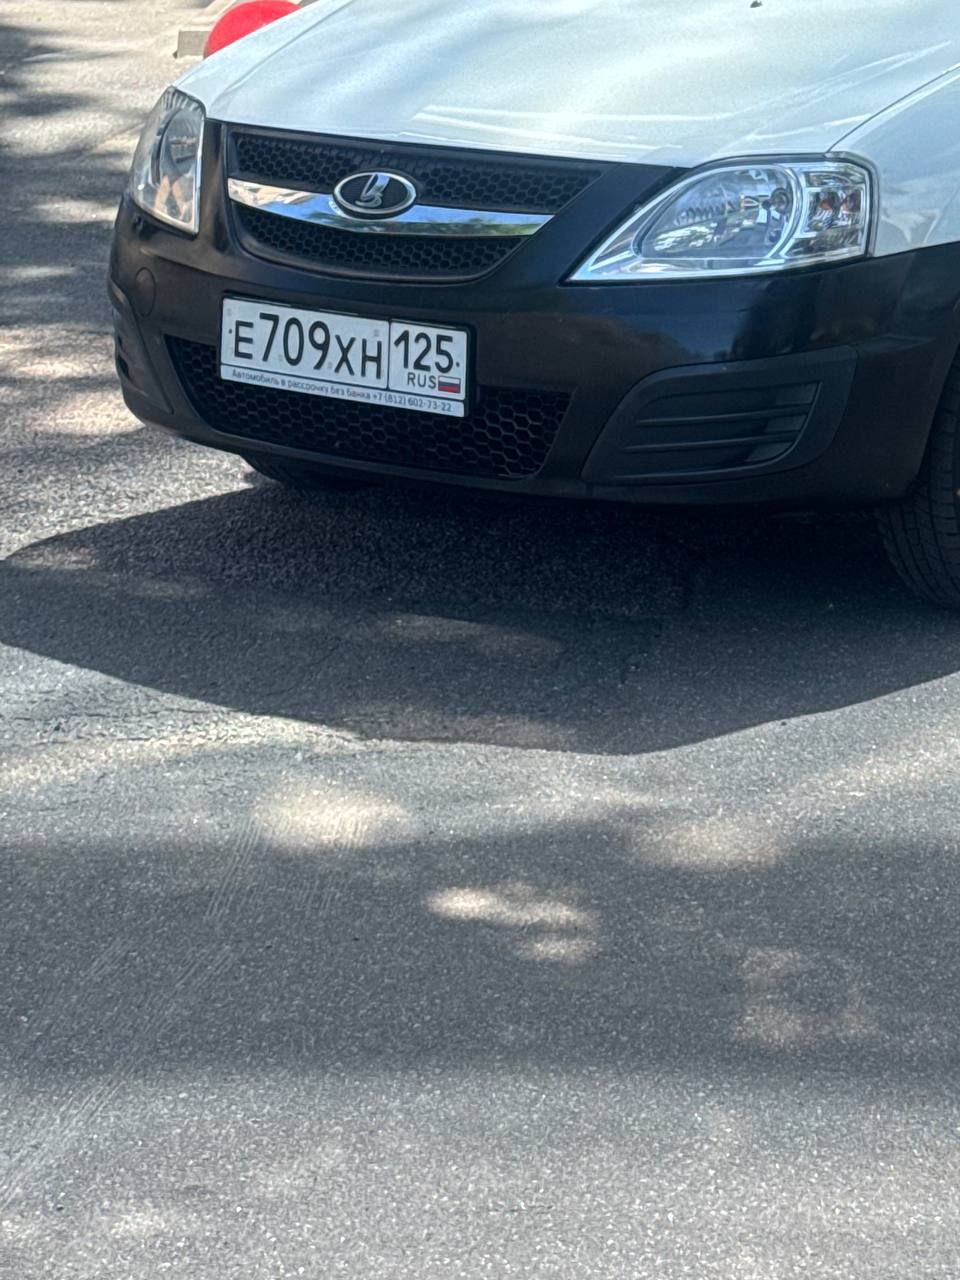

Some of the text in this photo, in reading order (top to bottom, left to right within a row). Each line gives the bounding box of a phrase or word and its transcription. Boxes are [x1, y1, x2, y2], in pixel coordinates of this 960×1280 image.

[234, 312, 454, 379] Е709ХН 125
[232, 368, 279, 386] Автомобиль
[287, 380, 329, 394] рассрочку
[330, 385, 345, 396] без
[346, 388, 371, 401] банка
[372, 392, 383, 401] +7
[407, 372, 436, 390] RUS
